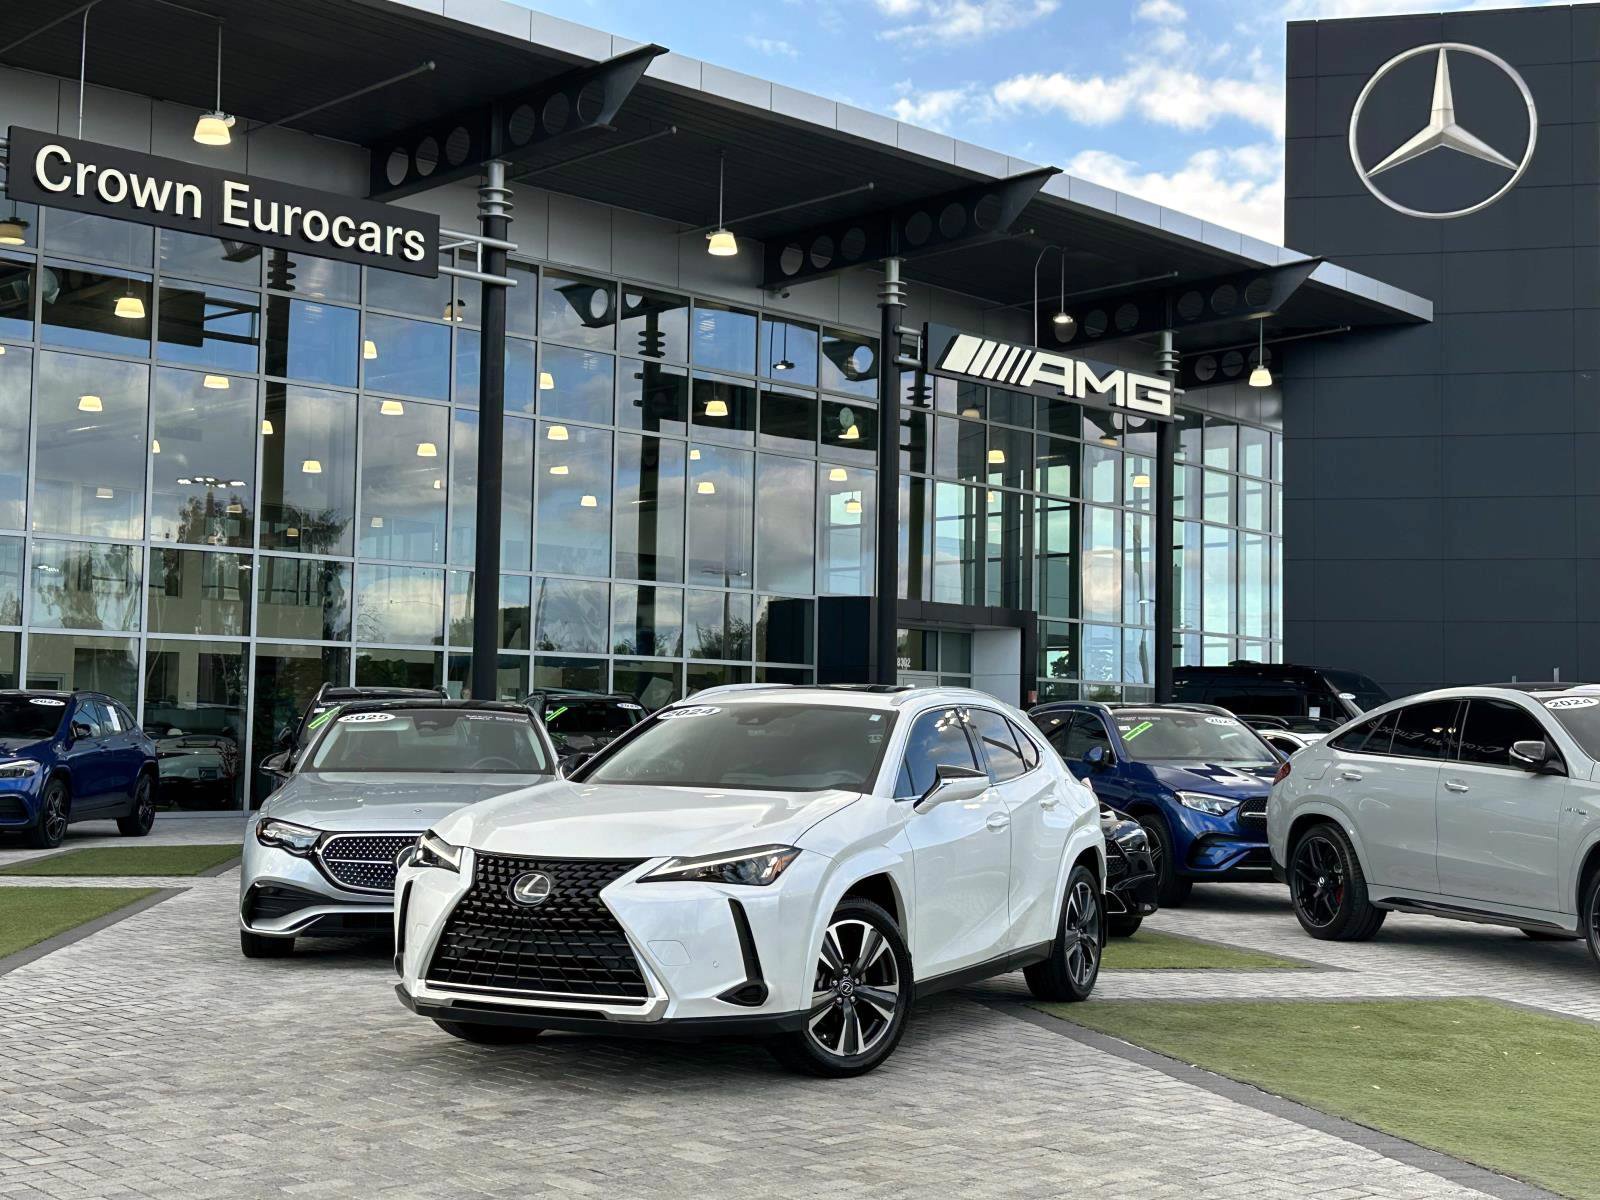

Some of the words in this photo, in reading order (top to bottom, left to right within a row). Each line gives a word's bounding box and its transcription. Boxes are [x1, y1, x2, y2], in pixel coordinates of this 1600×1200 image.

[35, 144, 202, 219] Crown
[221, 179, 426, 262] Eurocars
[1020, 351, 1171, 417] AMG
[662, 707, 716, 718] 2024
[1548, 698, 1594, 708] 2024
